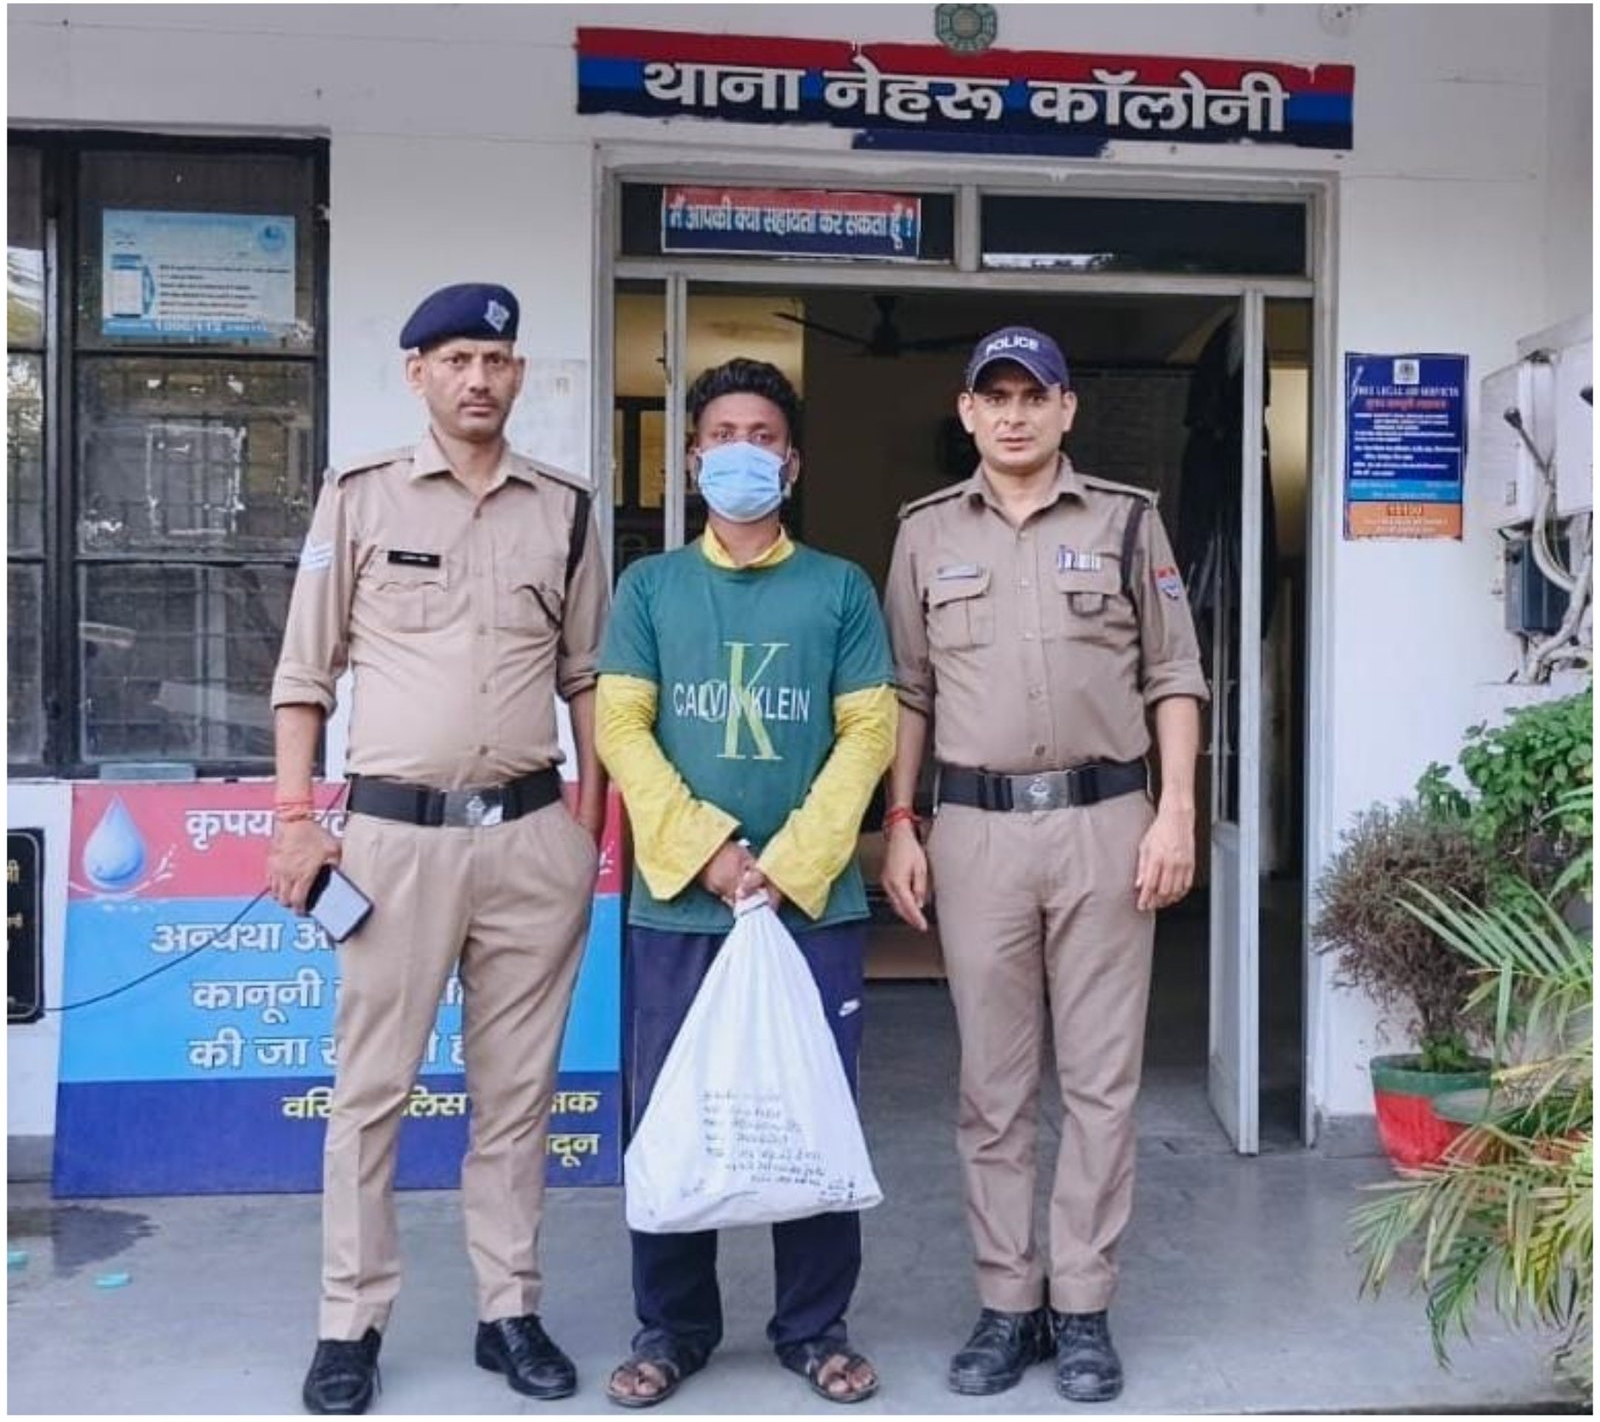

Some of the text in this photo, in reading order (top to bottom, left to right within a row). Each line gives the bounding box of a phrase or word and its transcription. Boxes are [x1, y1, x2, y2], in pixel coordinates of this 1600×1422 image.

[644, 55, 1290, 131] थाना नेहरू कॉलोनी
[985, 335, 1039, 357] POLICE
[716, 641, 791, 759] K
[751, 686, 811, 723] KLEIN
[151, 923, 284, 953] अन्यथा
[193, 969, 325, 1023] कानूनी
[189, 1027, 247, 1067] की
[254, 1038, 312, 1066] जा
